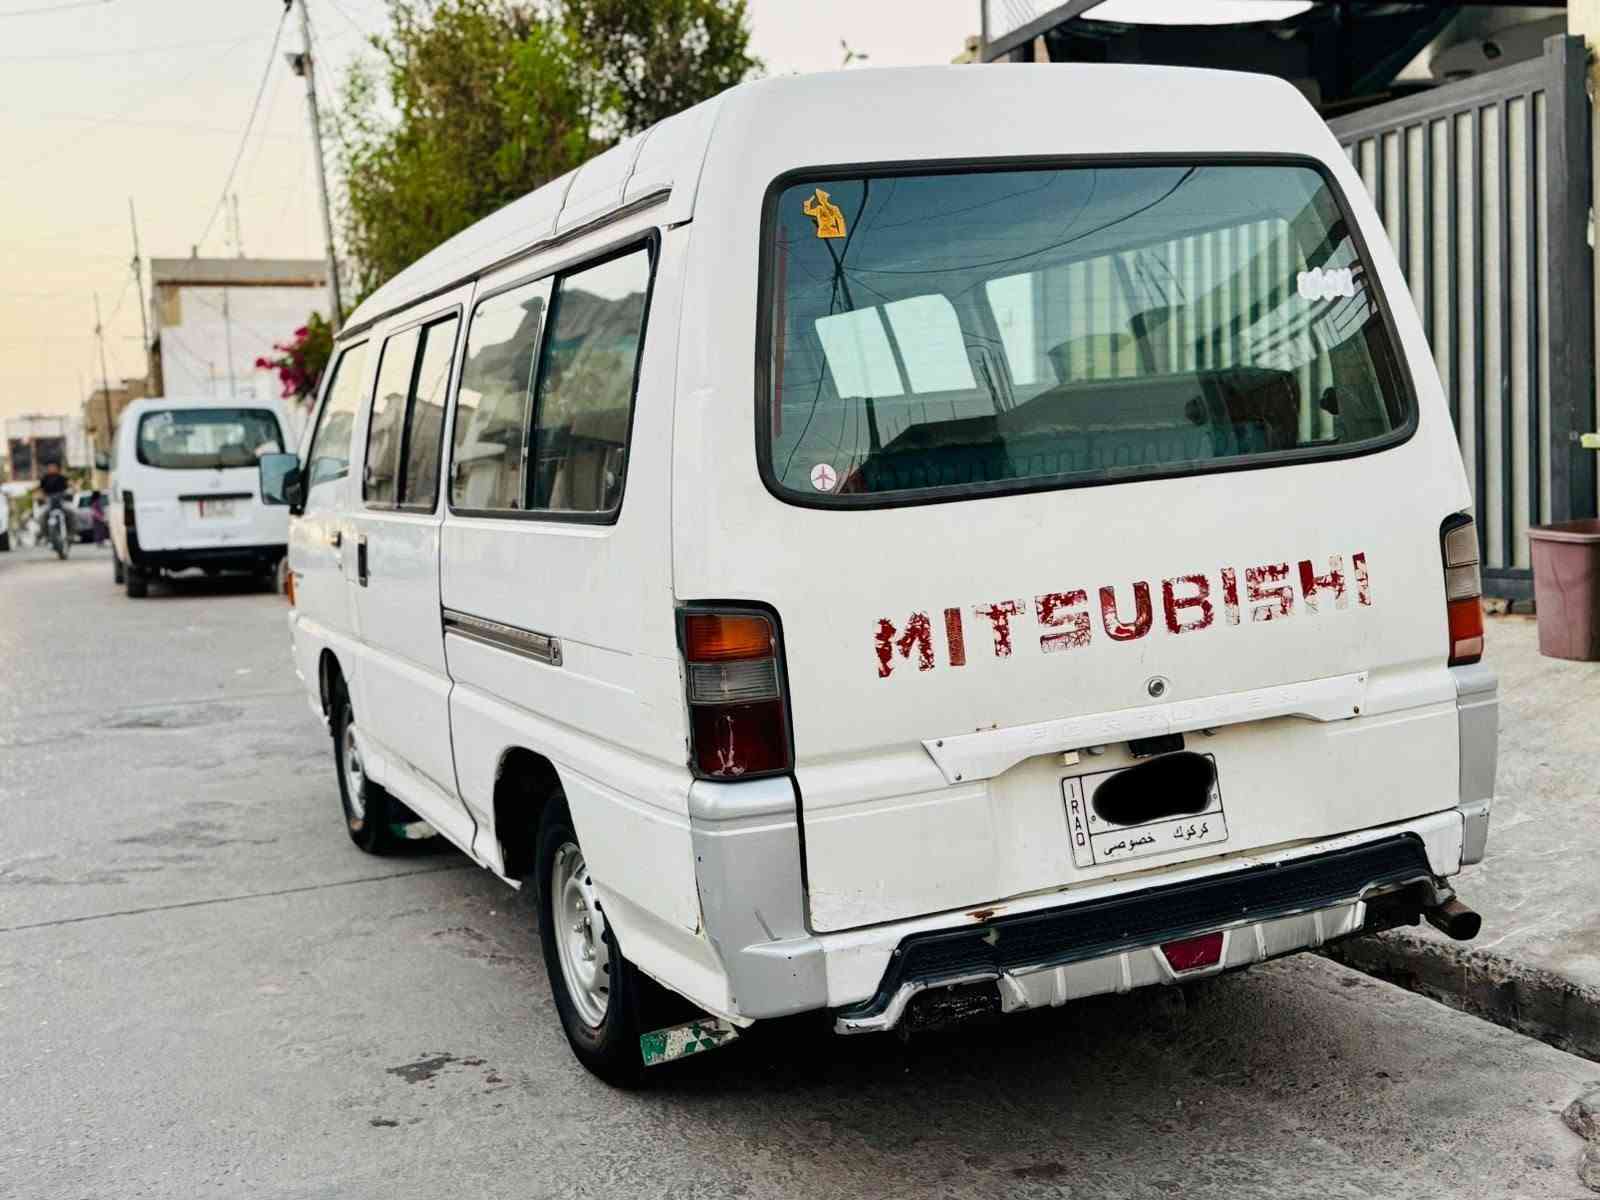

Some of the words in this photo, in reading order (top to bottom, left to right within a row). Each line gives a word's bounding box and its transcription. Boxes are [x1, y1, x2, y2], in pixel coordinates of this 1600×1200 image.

[874, 552, 1371, 677] MITSUBISHI
[1070, 783, 1086, 847] IRAQ
[1173, 822, 1209, 841] كركوك
